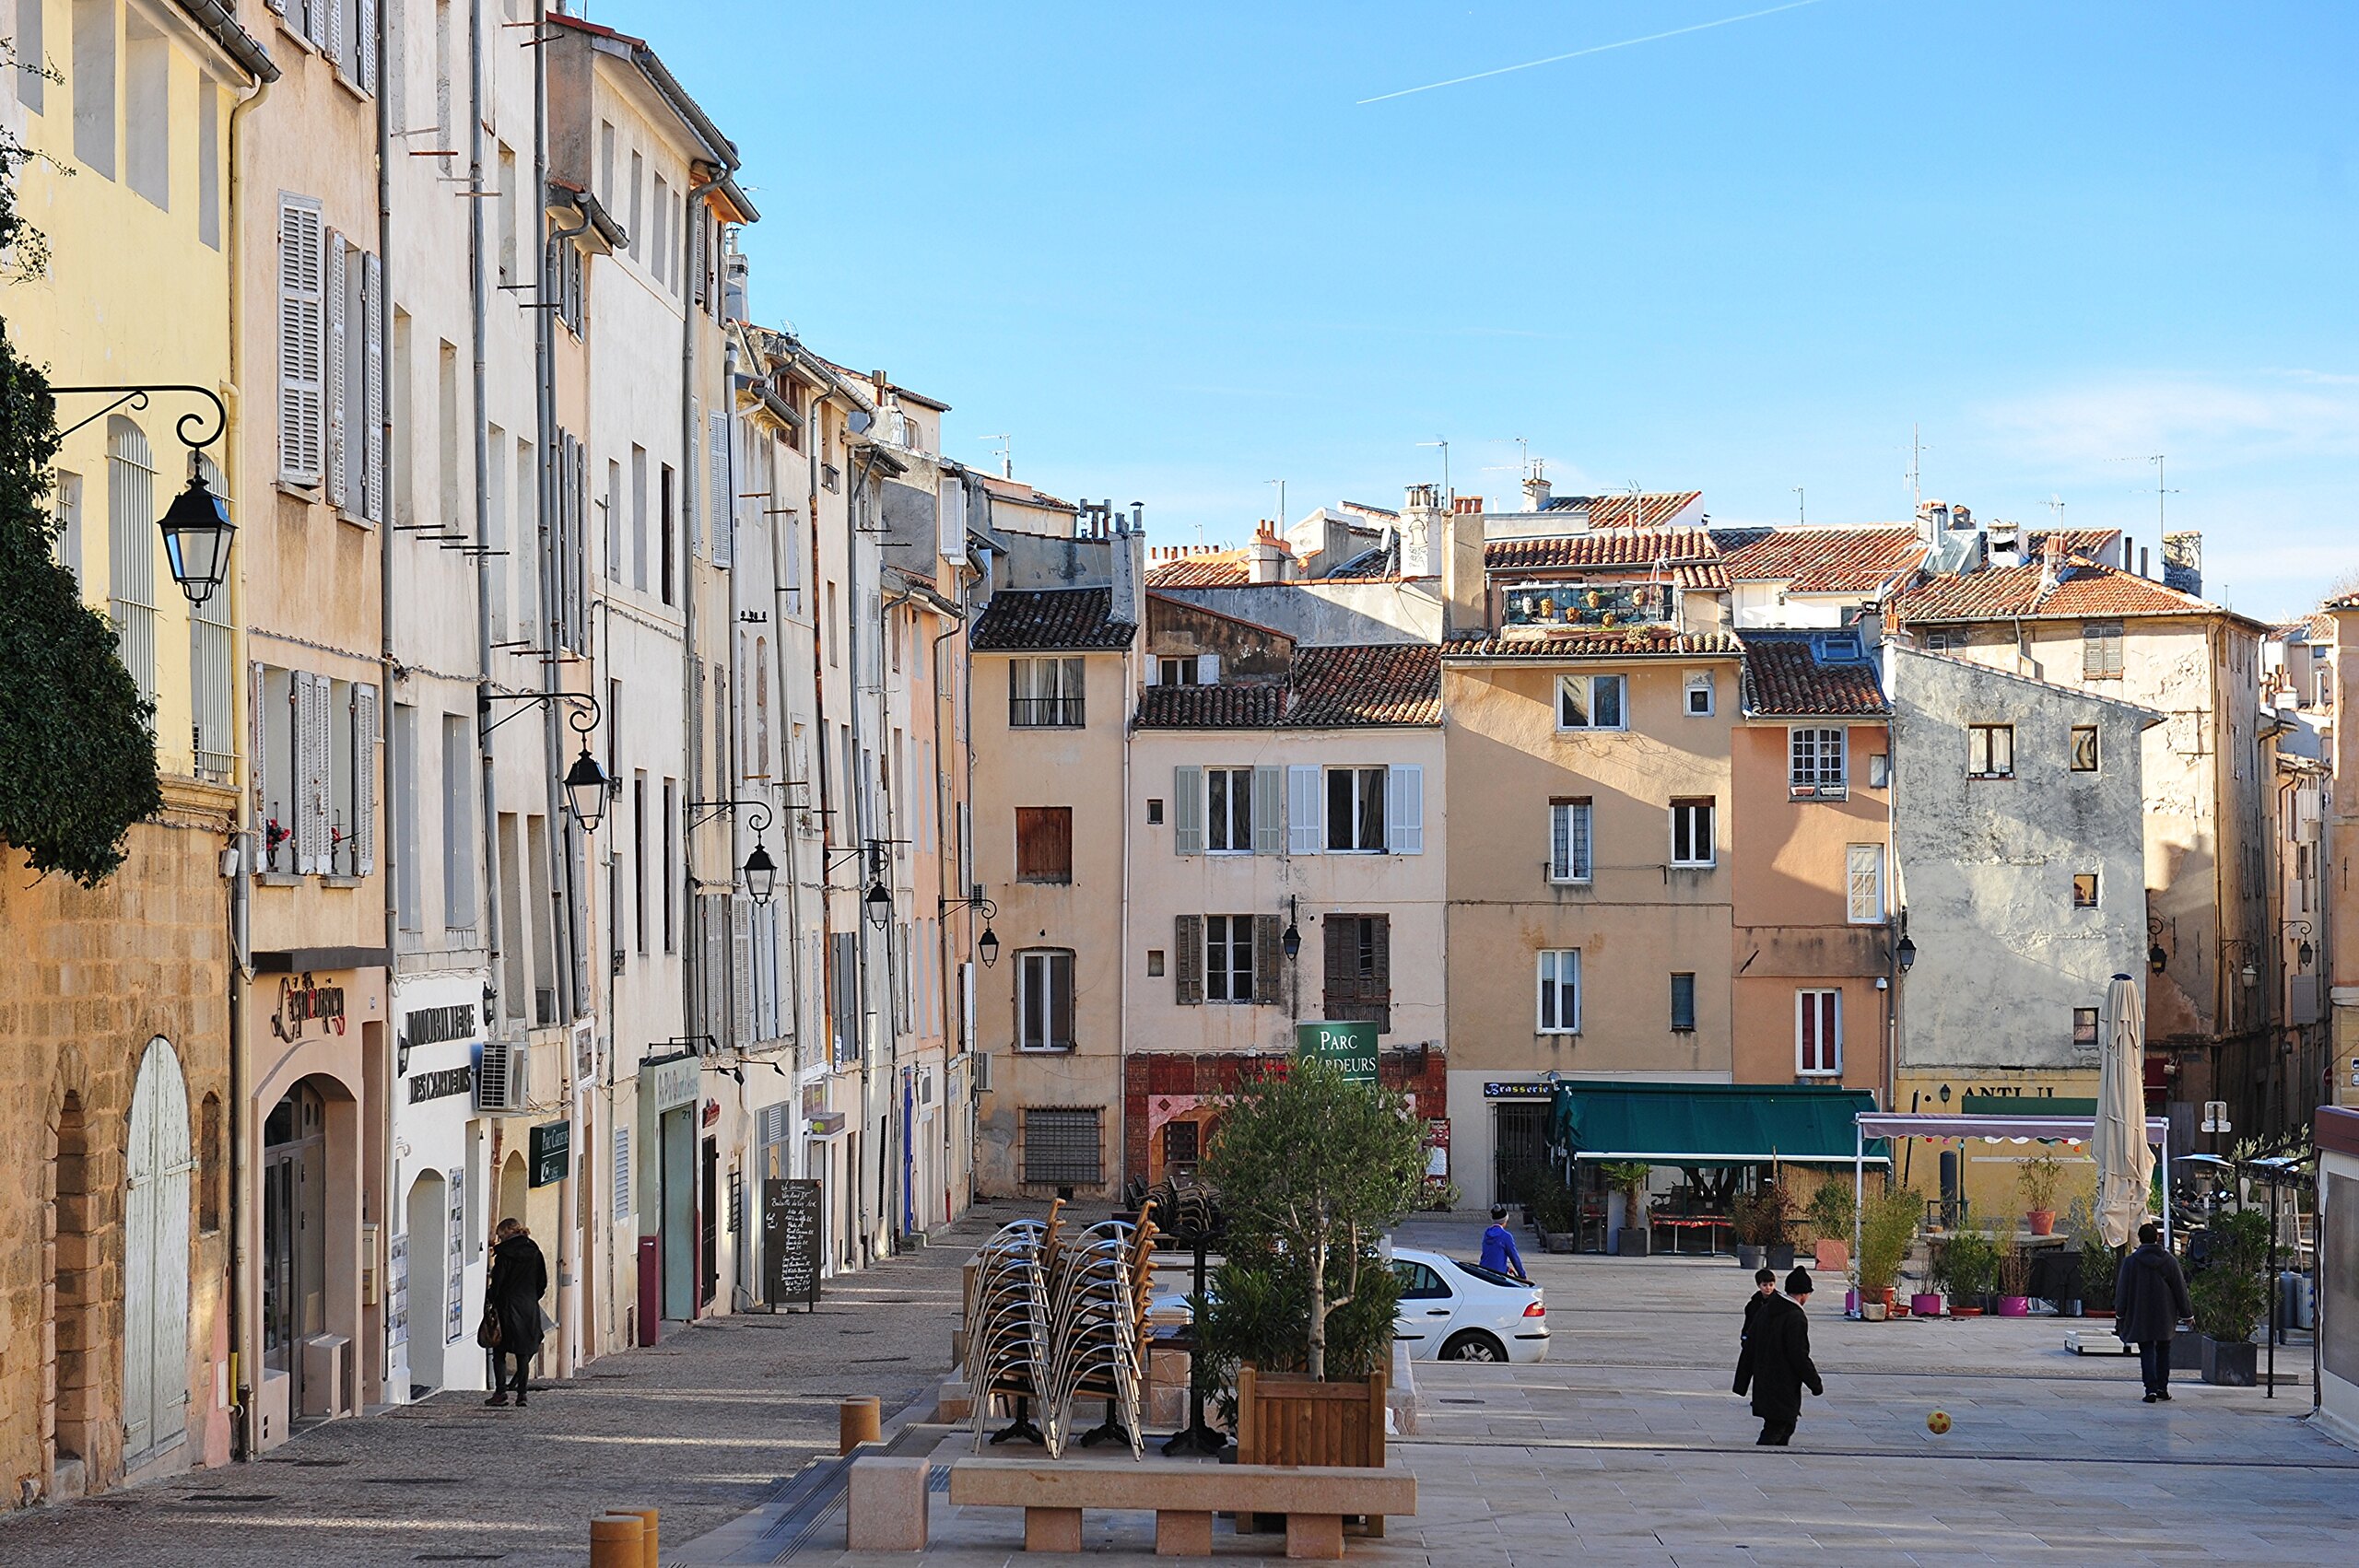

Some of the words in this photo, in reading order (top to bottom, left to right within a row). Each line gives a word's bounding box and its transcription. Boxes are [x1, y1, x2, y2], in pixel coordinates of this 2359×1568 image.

[1320, 1031, 1358, 1051] PARC
[1485, 1082, 1549, 1095] Brasserie
[682, 1110, 691, 1120] 21
